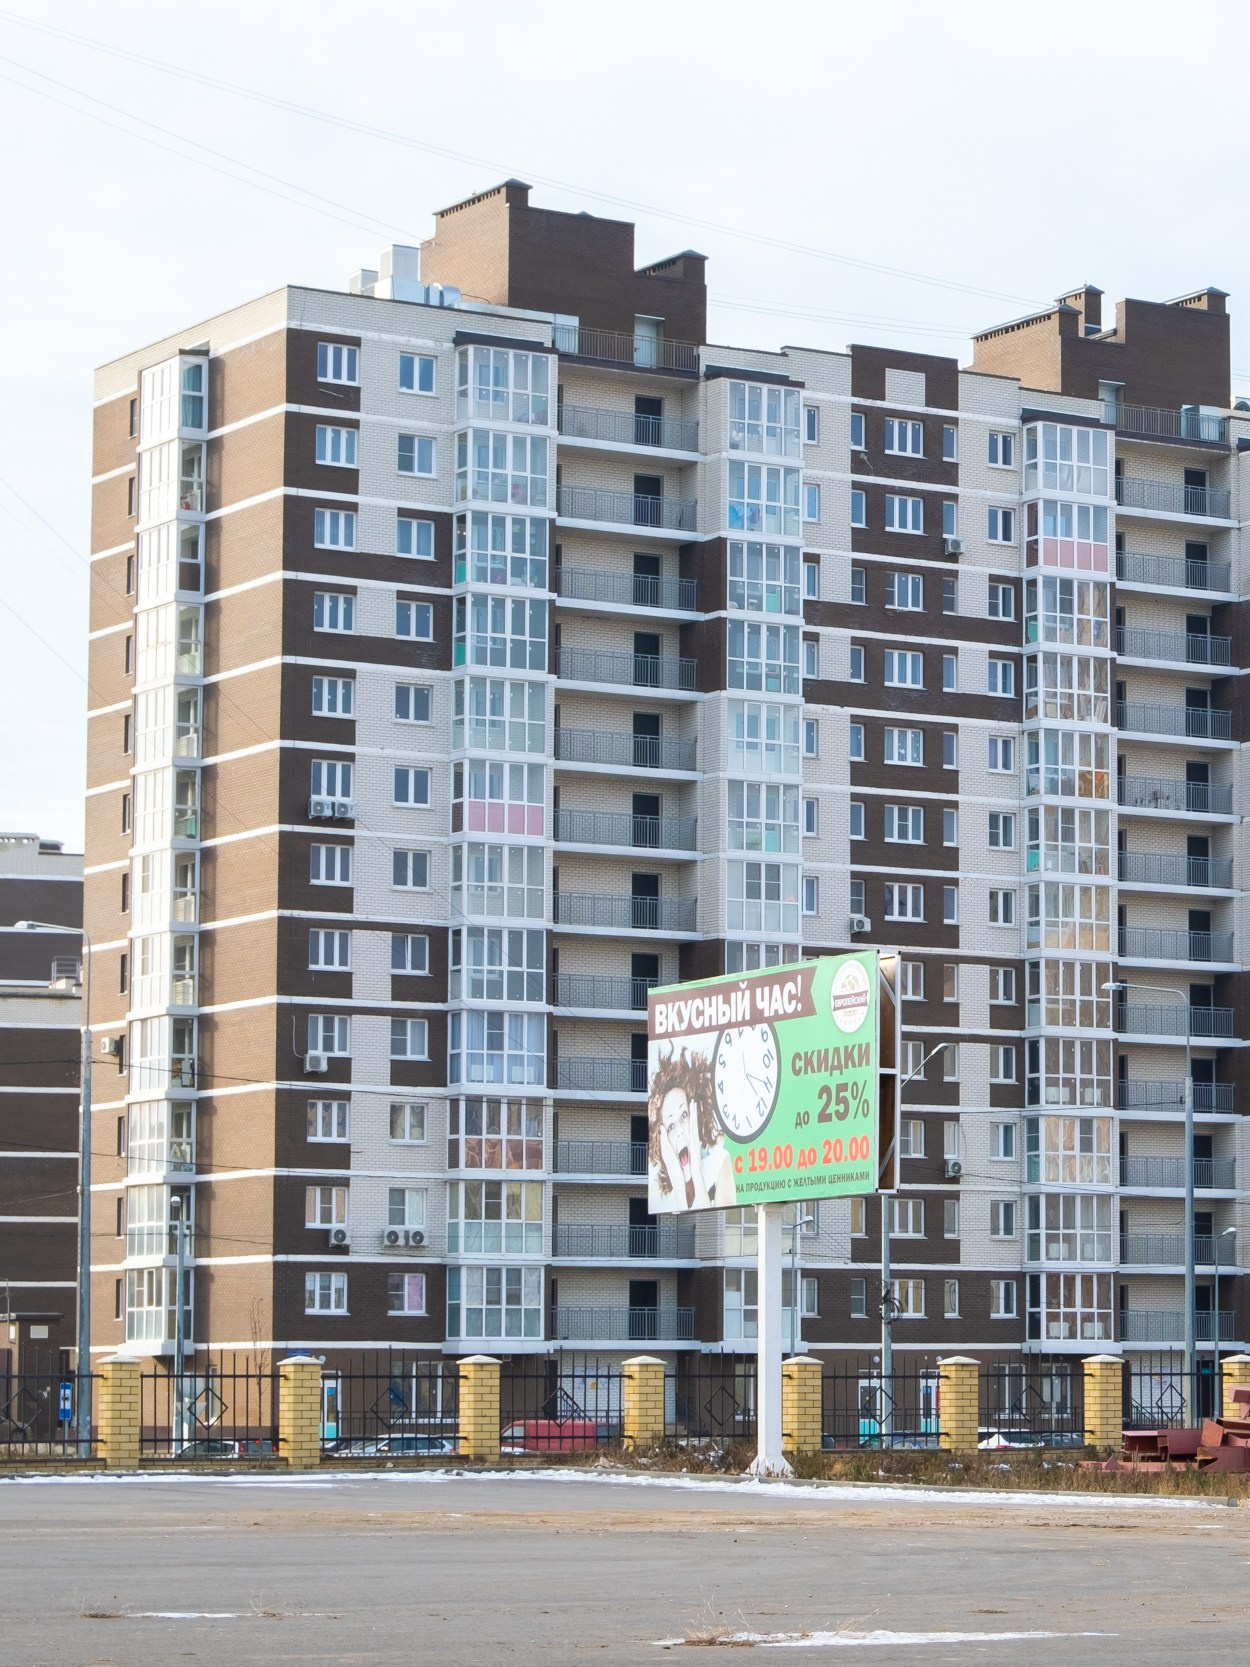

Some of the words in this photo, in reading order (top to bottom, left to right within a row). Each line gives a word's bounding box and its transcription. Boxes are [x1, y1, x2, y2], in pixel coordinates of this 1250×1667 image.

[654, 981, 750, 1034] ВКУСНЫЙ
[755, 974, 802, 1017] ЧАС!
[791, 1042, 871, 1077] СКИДКИ
[795, 1110, 810, 1130] до
[817, 1079, 870, 1124] 25%
[748, 1144, 793, 1173] 19.00
[797, 1147, 817, 1170] до
[822, 1135, 870, 1165] 20.00
[735, 1183, 745, 1193] НА
[745, 1179, 786, 1193] ПРОДУКЦИЮ
[787, 1178, 792, 1189] С
[793, 1173, 827, 1188] ЖЕЛТЫМИ
[828, 1170, 870, 1185] ЦЕННИКАМИ
